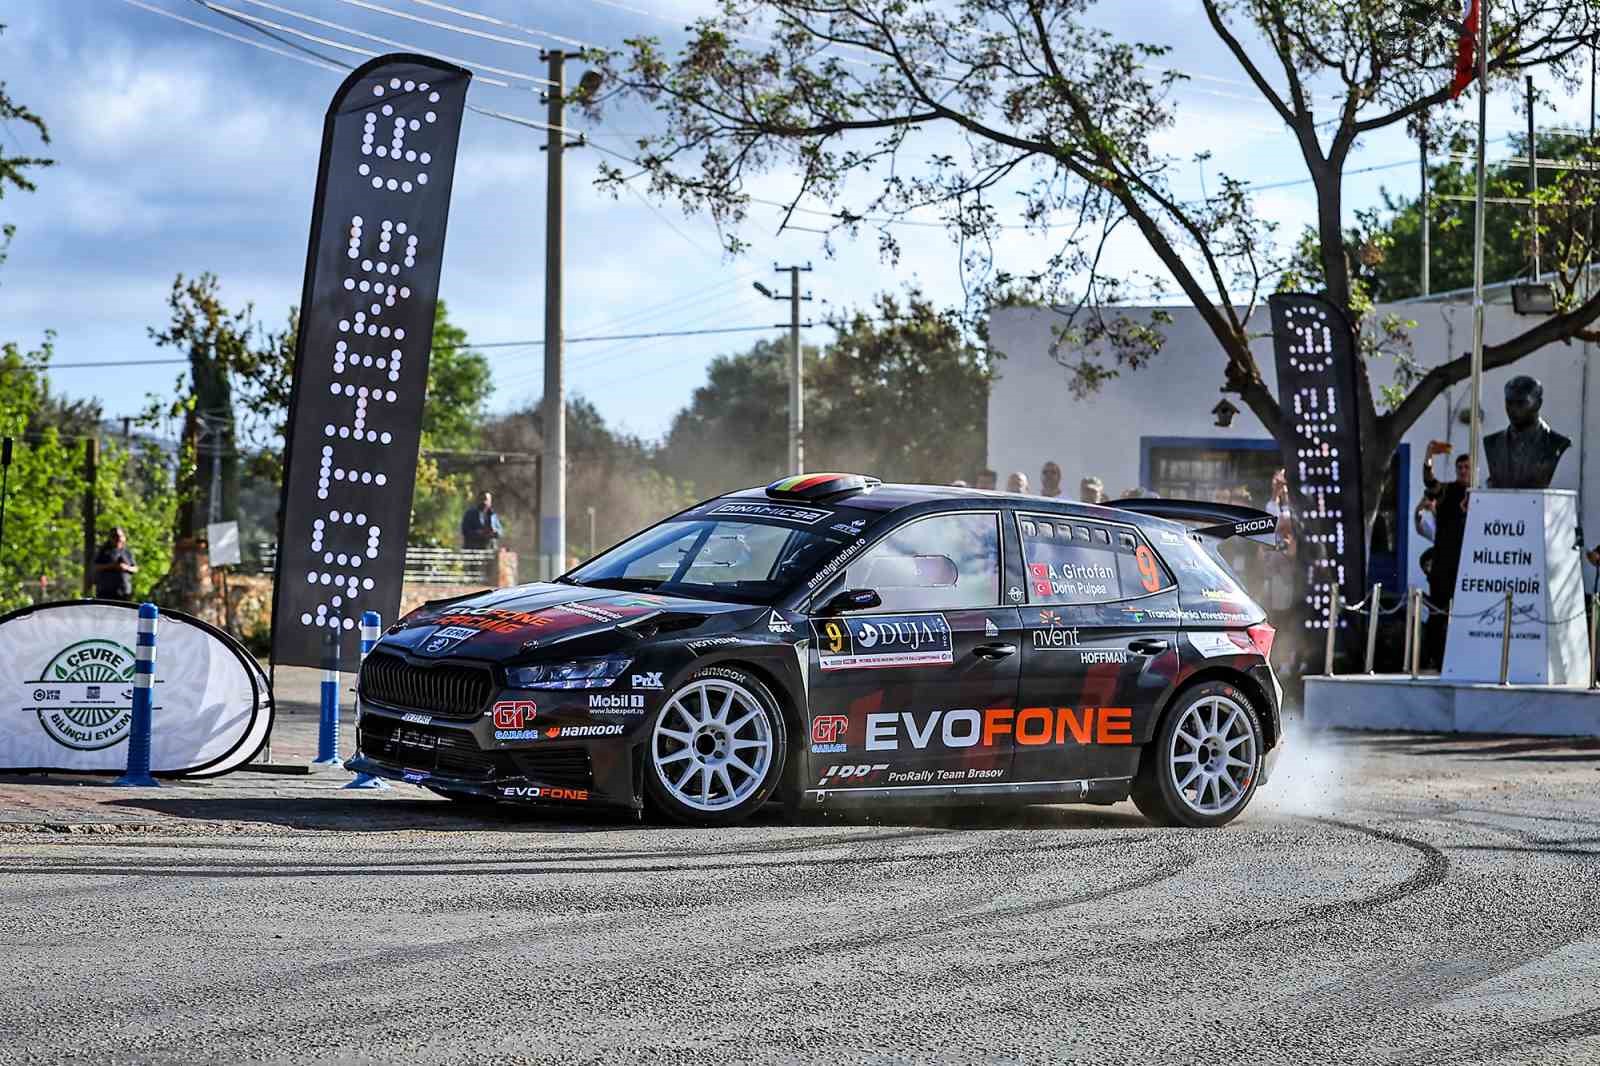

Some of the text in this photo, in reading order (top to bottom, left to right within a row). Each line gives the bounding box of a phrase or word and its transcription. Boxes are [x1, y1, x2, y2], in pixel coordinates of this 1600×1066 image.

[301, 214, 418, 631] NOTHING
[720, 503, 819, 522] DINAMIC92
[1484, 521, 1525, 537] KÖYLÜ
[807, 537, 867, 590] andreigirtofan.ro
[1473, 548, 1532, 565] MİLLETİN
[1048, 563, 1114, 579] A. Girtofan
[1136, 544, 1161, 592] 9
[1052, 582, 1106, 596] Dorin Pulpea
[1461, 577, 1540, 595] EFENDİSİDİR
[825, 622, 843, 654] 9
[877, 621, 936, 650] DUJA
[66, 648, 125, 668] ÇEVRE
[1080, 652, 1128, 664] HOFFMAN
[589, 694, 628, 708] Mobil
[493, 700, 537, 729] GP
[51, 712, 133, 742] BİLİNÇLİ EYLEM
[495, 729, 539, 740] GARAGE
[812, 715, 849, 743] GP
[865, 707, 1133, 751] EVOFONE
[811, 744, 848, 753] GARAGE
[887, 768, 1004, 782] ProRally Team Brasov
[503, 786, 589, 801] EVOFONE
